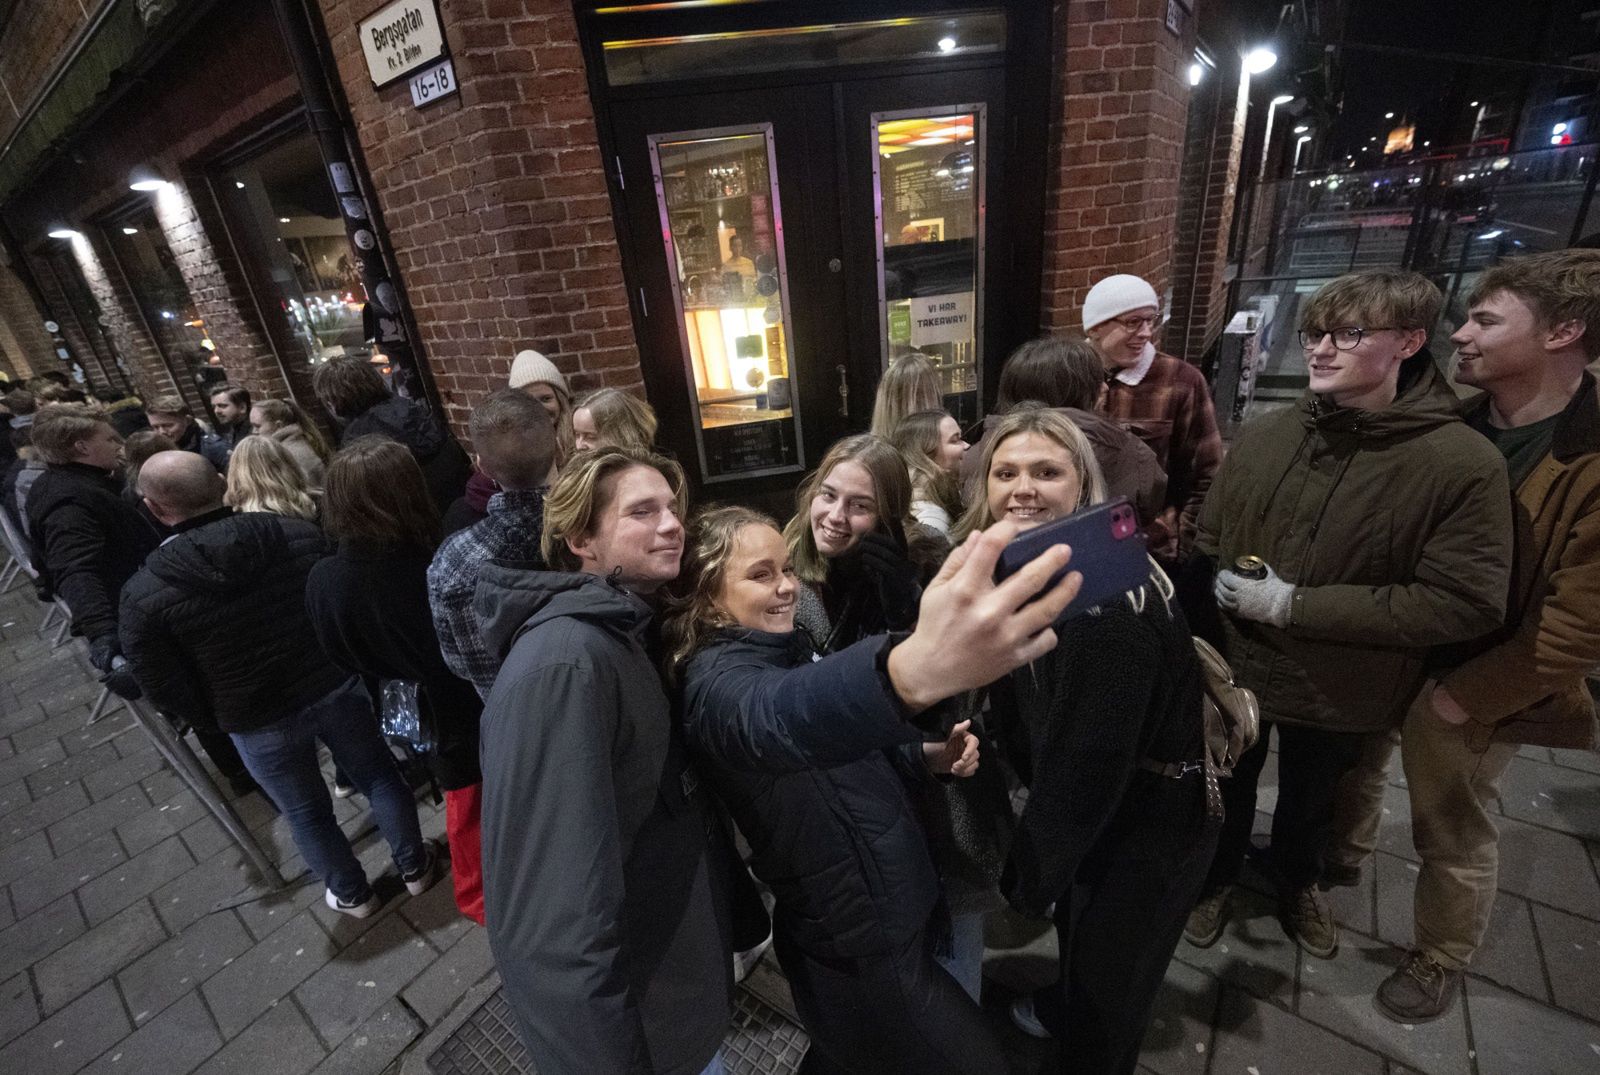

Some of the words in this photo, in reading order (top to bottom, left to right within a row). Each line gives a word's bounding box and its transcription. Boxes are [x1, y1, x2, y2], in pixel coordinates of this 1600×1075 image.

[371, 8, 424, 52] Bergsgatan
[415, 67, 449, 100] 16-18
[928, 304, 937, 313] VI
[939, 302, 956, 312] HAR
[917, 314, 967, 328] TAKEAWAY!
